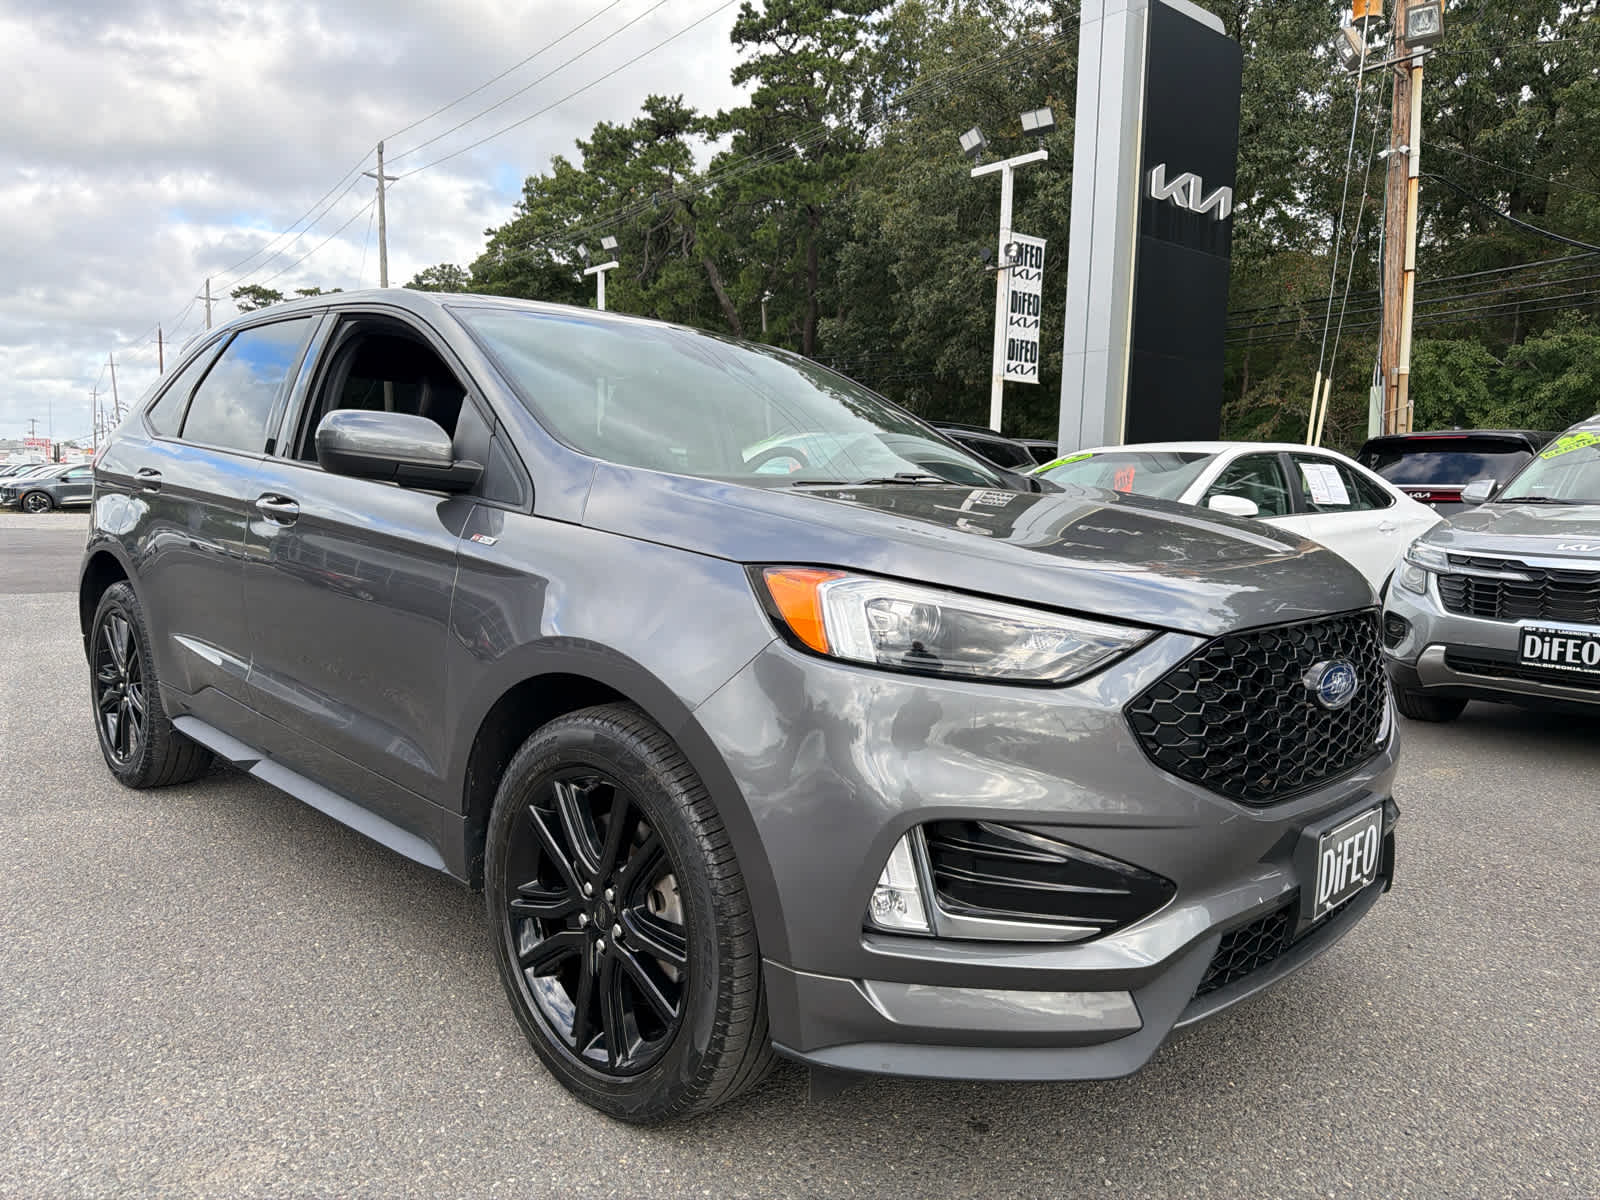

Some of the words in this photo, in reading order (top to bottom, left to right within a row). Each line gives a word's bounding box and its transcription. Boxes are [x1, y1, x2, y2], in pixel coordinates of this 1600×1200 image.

[1151, 163, 1232, 220] KIA
[1012, 265, 1041, 281] KIA
[1010, 290, 1040, 317] DiFEO
[1009, 316, 1039, 328] KIA
[1007, 338, 1037, 363] DiFEO
[1006, 363, 1036, 375] KIA
[1523, 635, 1600, 666] DiFEO
[1319, 825, 1377, 904] DiFEO
